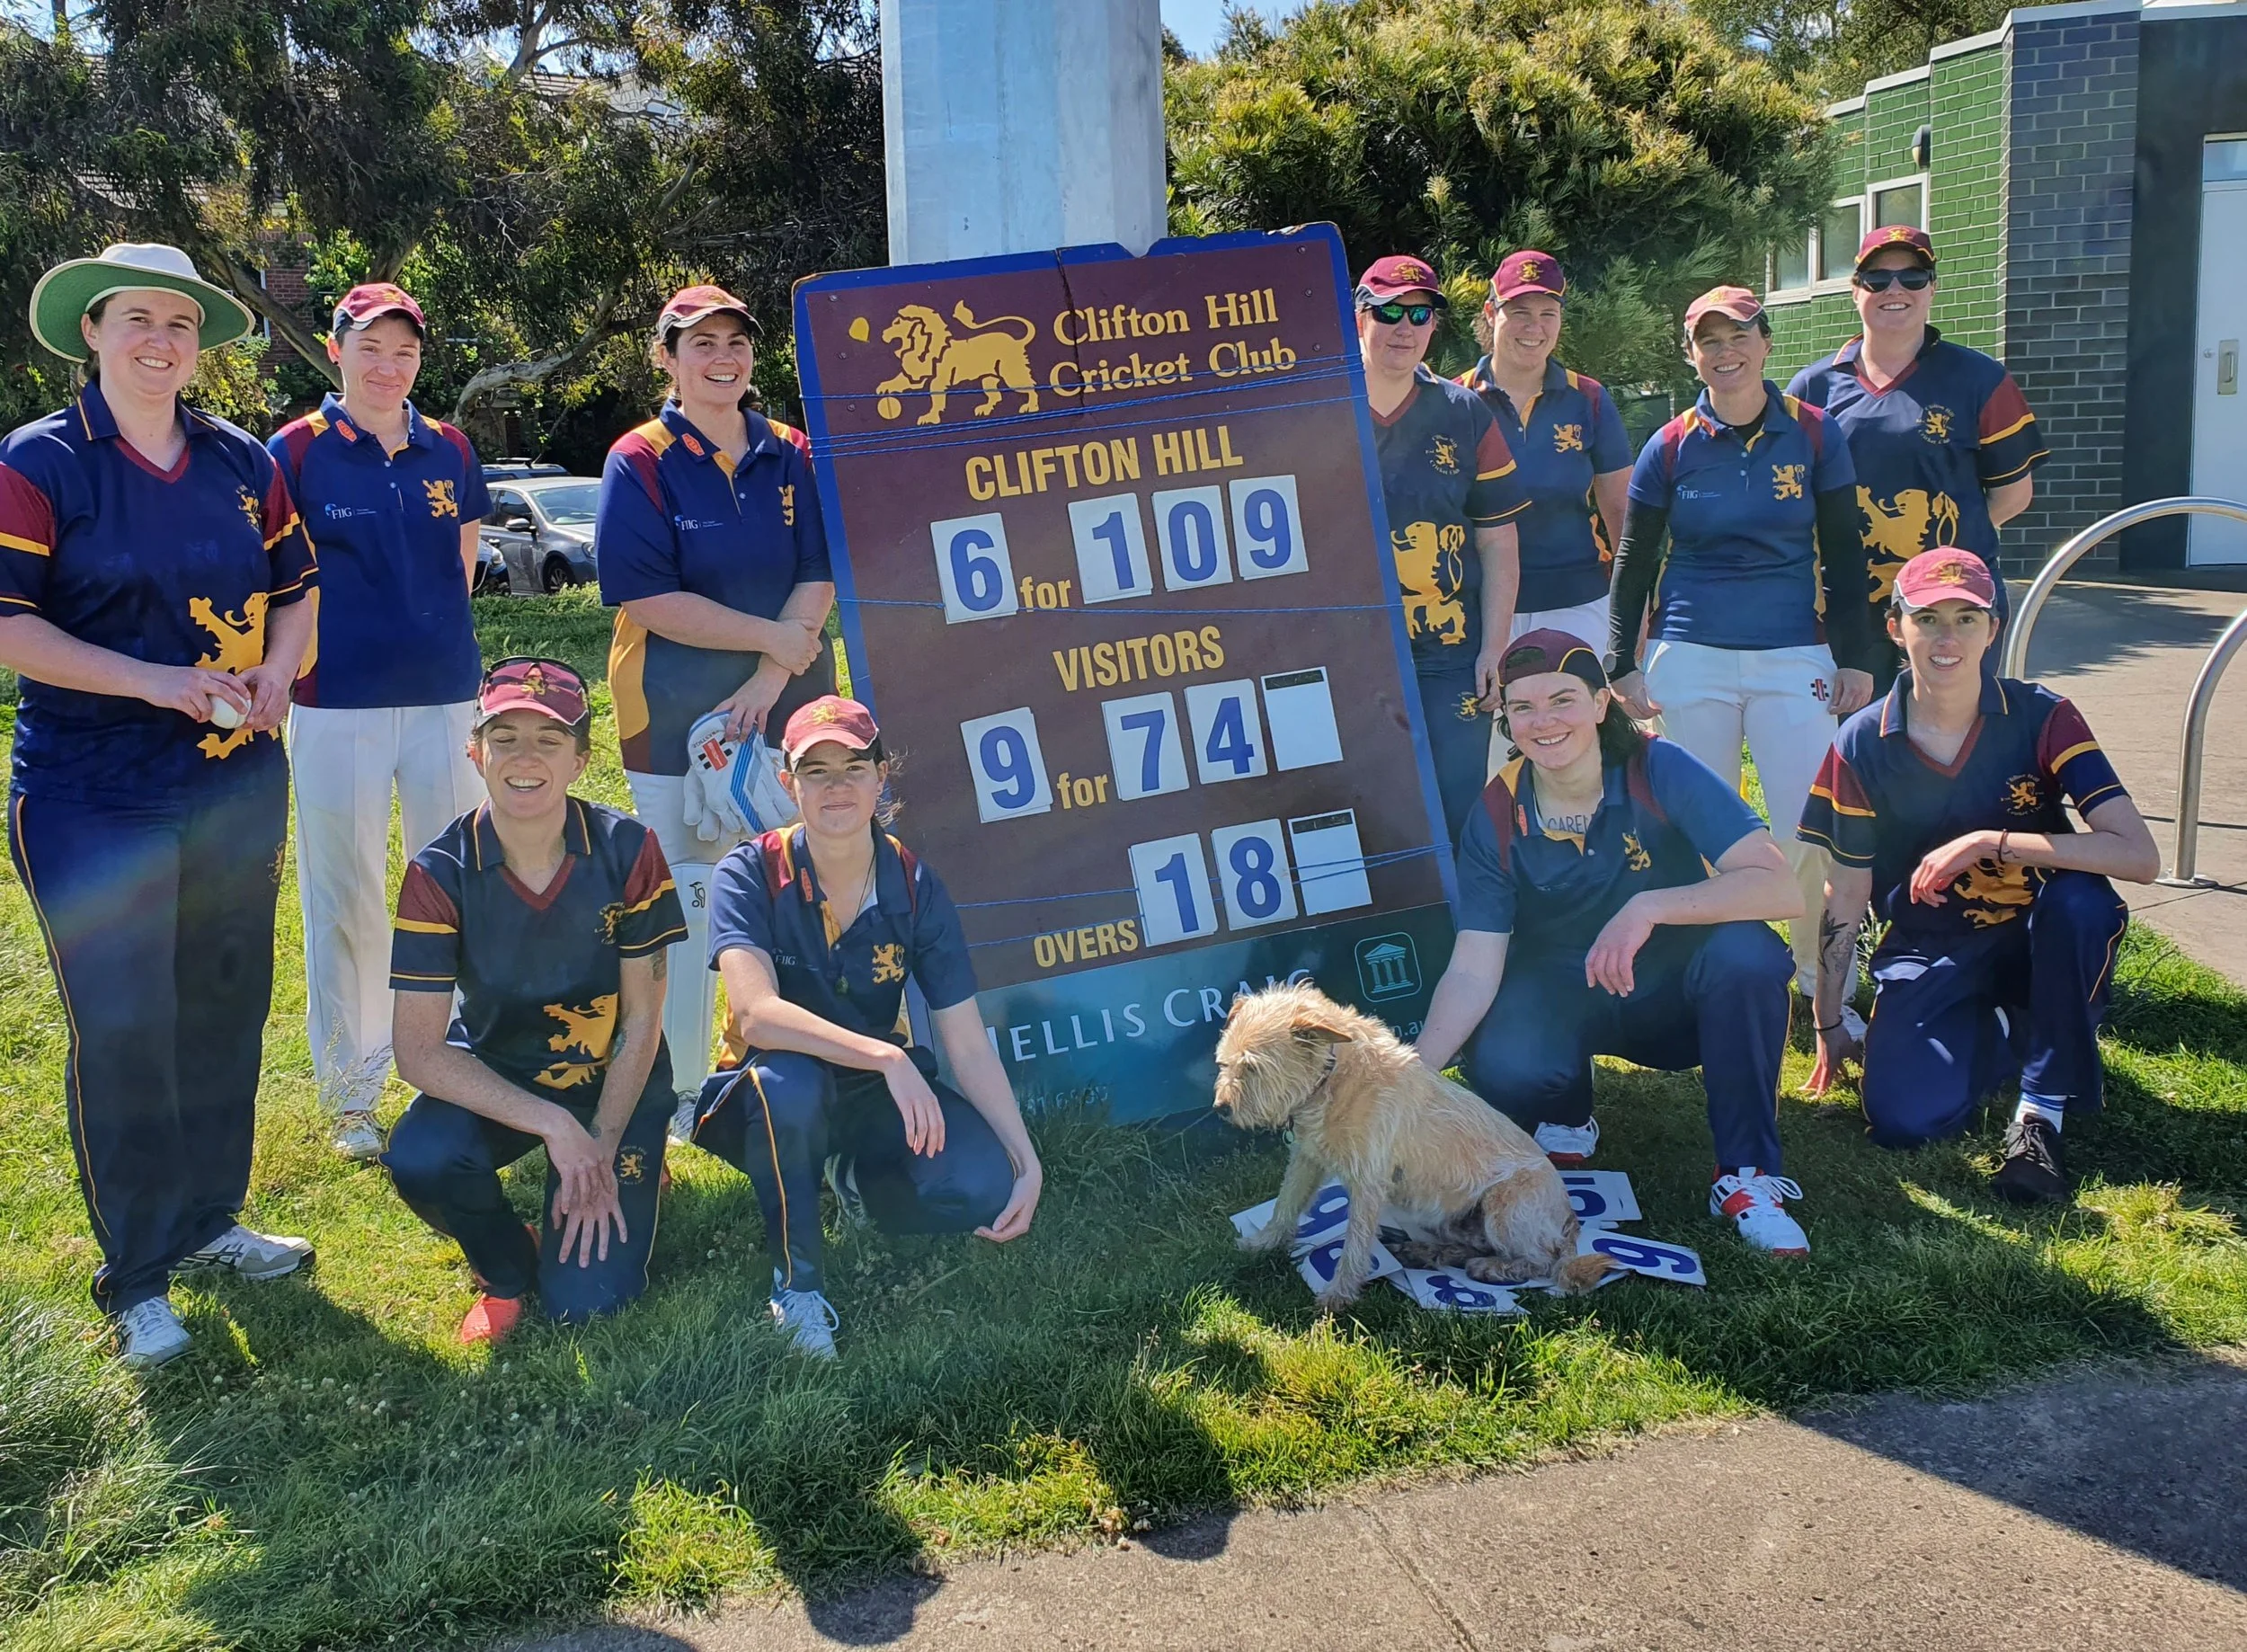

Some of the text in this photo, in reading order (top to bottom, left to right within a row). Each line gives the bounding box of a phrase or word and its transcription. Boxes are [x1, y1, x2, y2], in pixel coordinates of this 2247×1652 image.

[1053, 289, 1279, 348] Clifton Hill
[1049, 338, 1297, 398] Cricket Club
[965, 426, 1244, 501] CLIFTON HILL
[949, 528, 1005, 612] 6
[1019, 576, 1071, 612] for
[1053, 626, 1225, 692] VISITORS
[981, 725, 1036, 810] 9
[1057, 772, 1108, 810] for
[1034, 919, 1140, 969] OVERS
